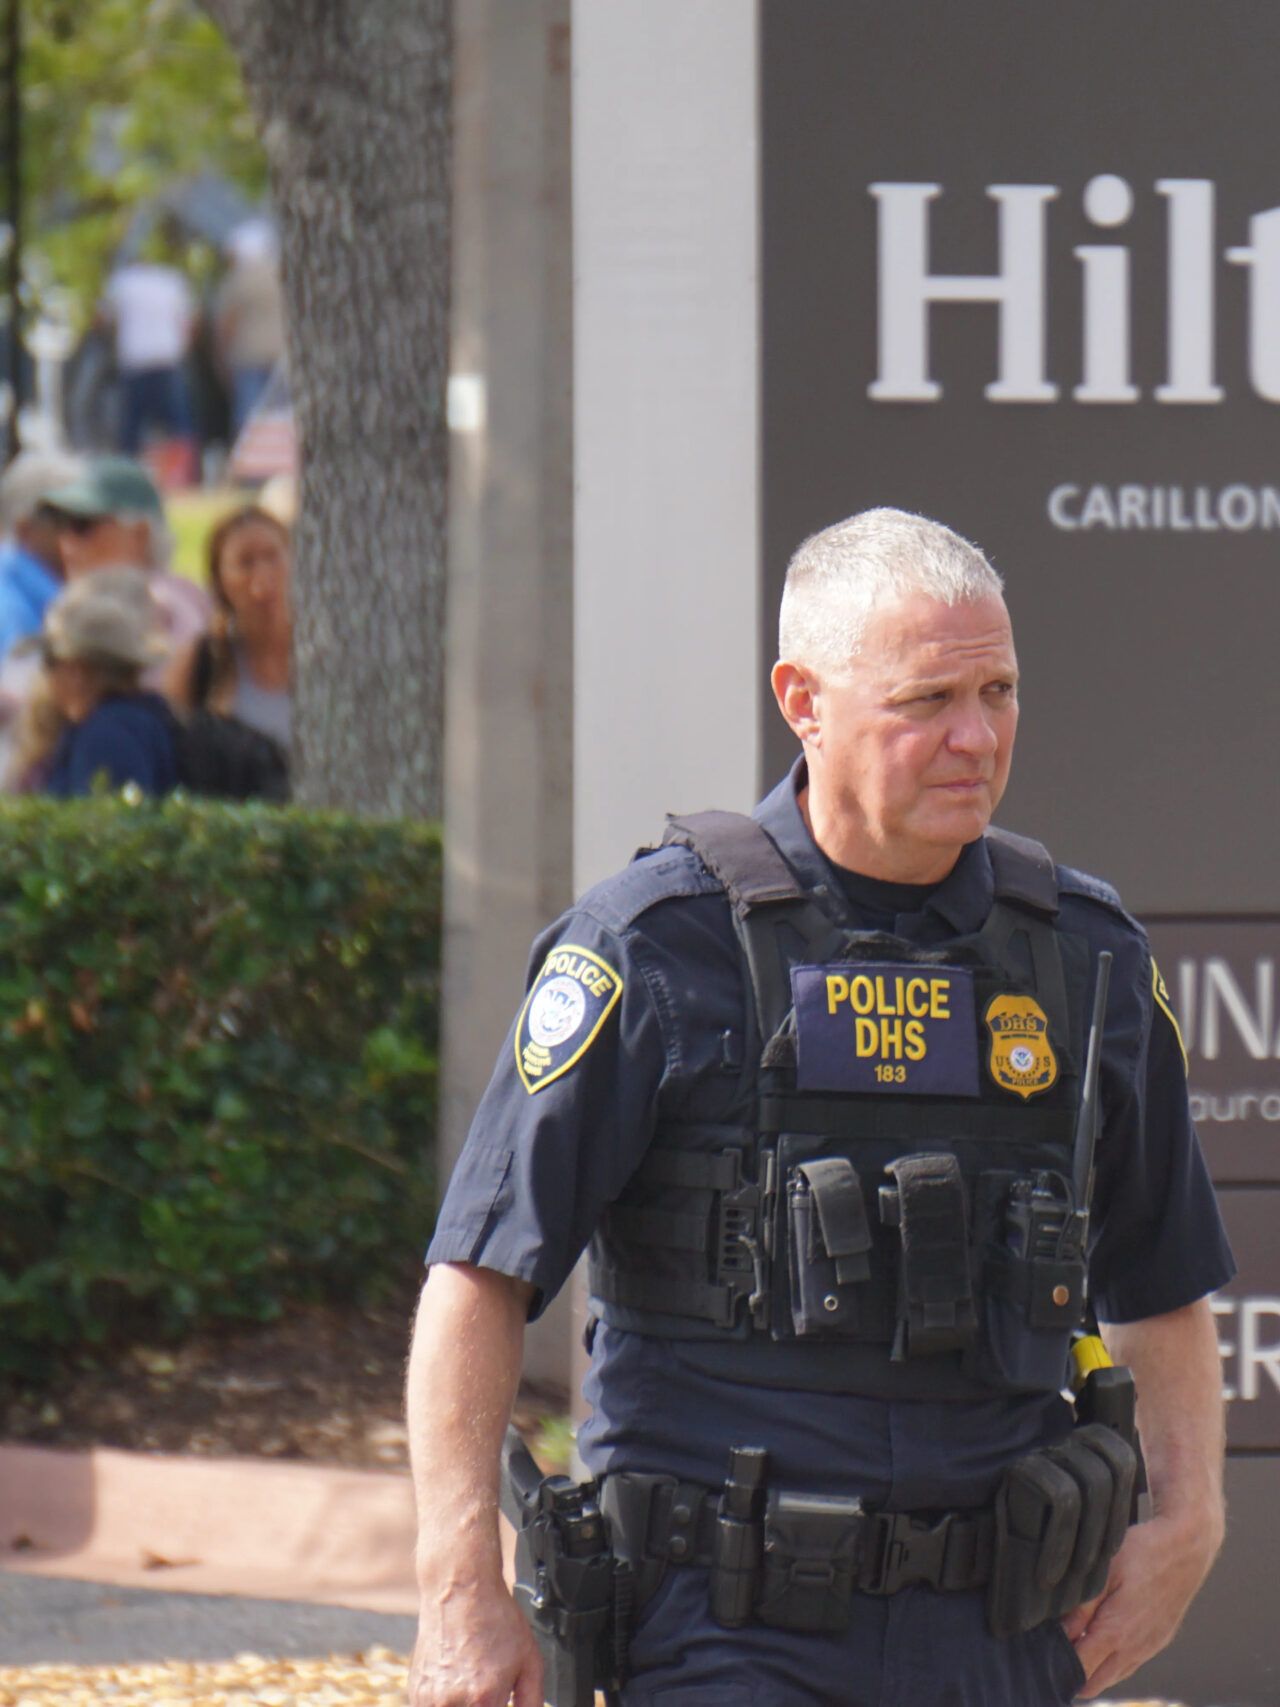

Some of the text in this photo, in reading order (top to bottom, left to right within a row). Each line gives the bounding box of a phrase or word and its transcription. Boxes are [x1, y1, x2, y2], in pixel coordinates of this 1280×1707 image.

[544, 953, 613, 998] POLICE
[826, 974, 950, 1019] POLICE
[855, 1017, 927, 1061] DHS
[874, 1064, 907, 1083] 183
